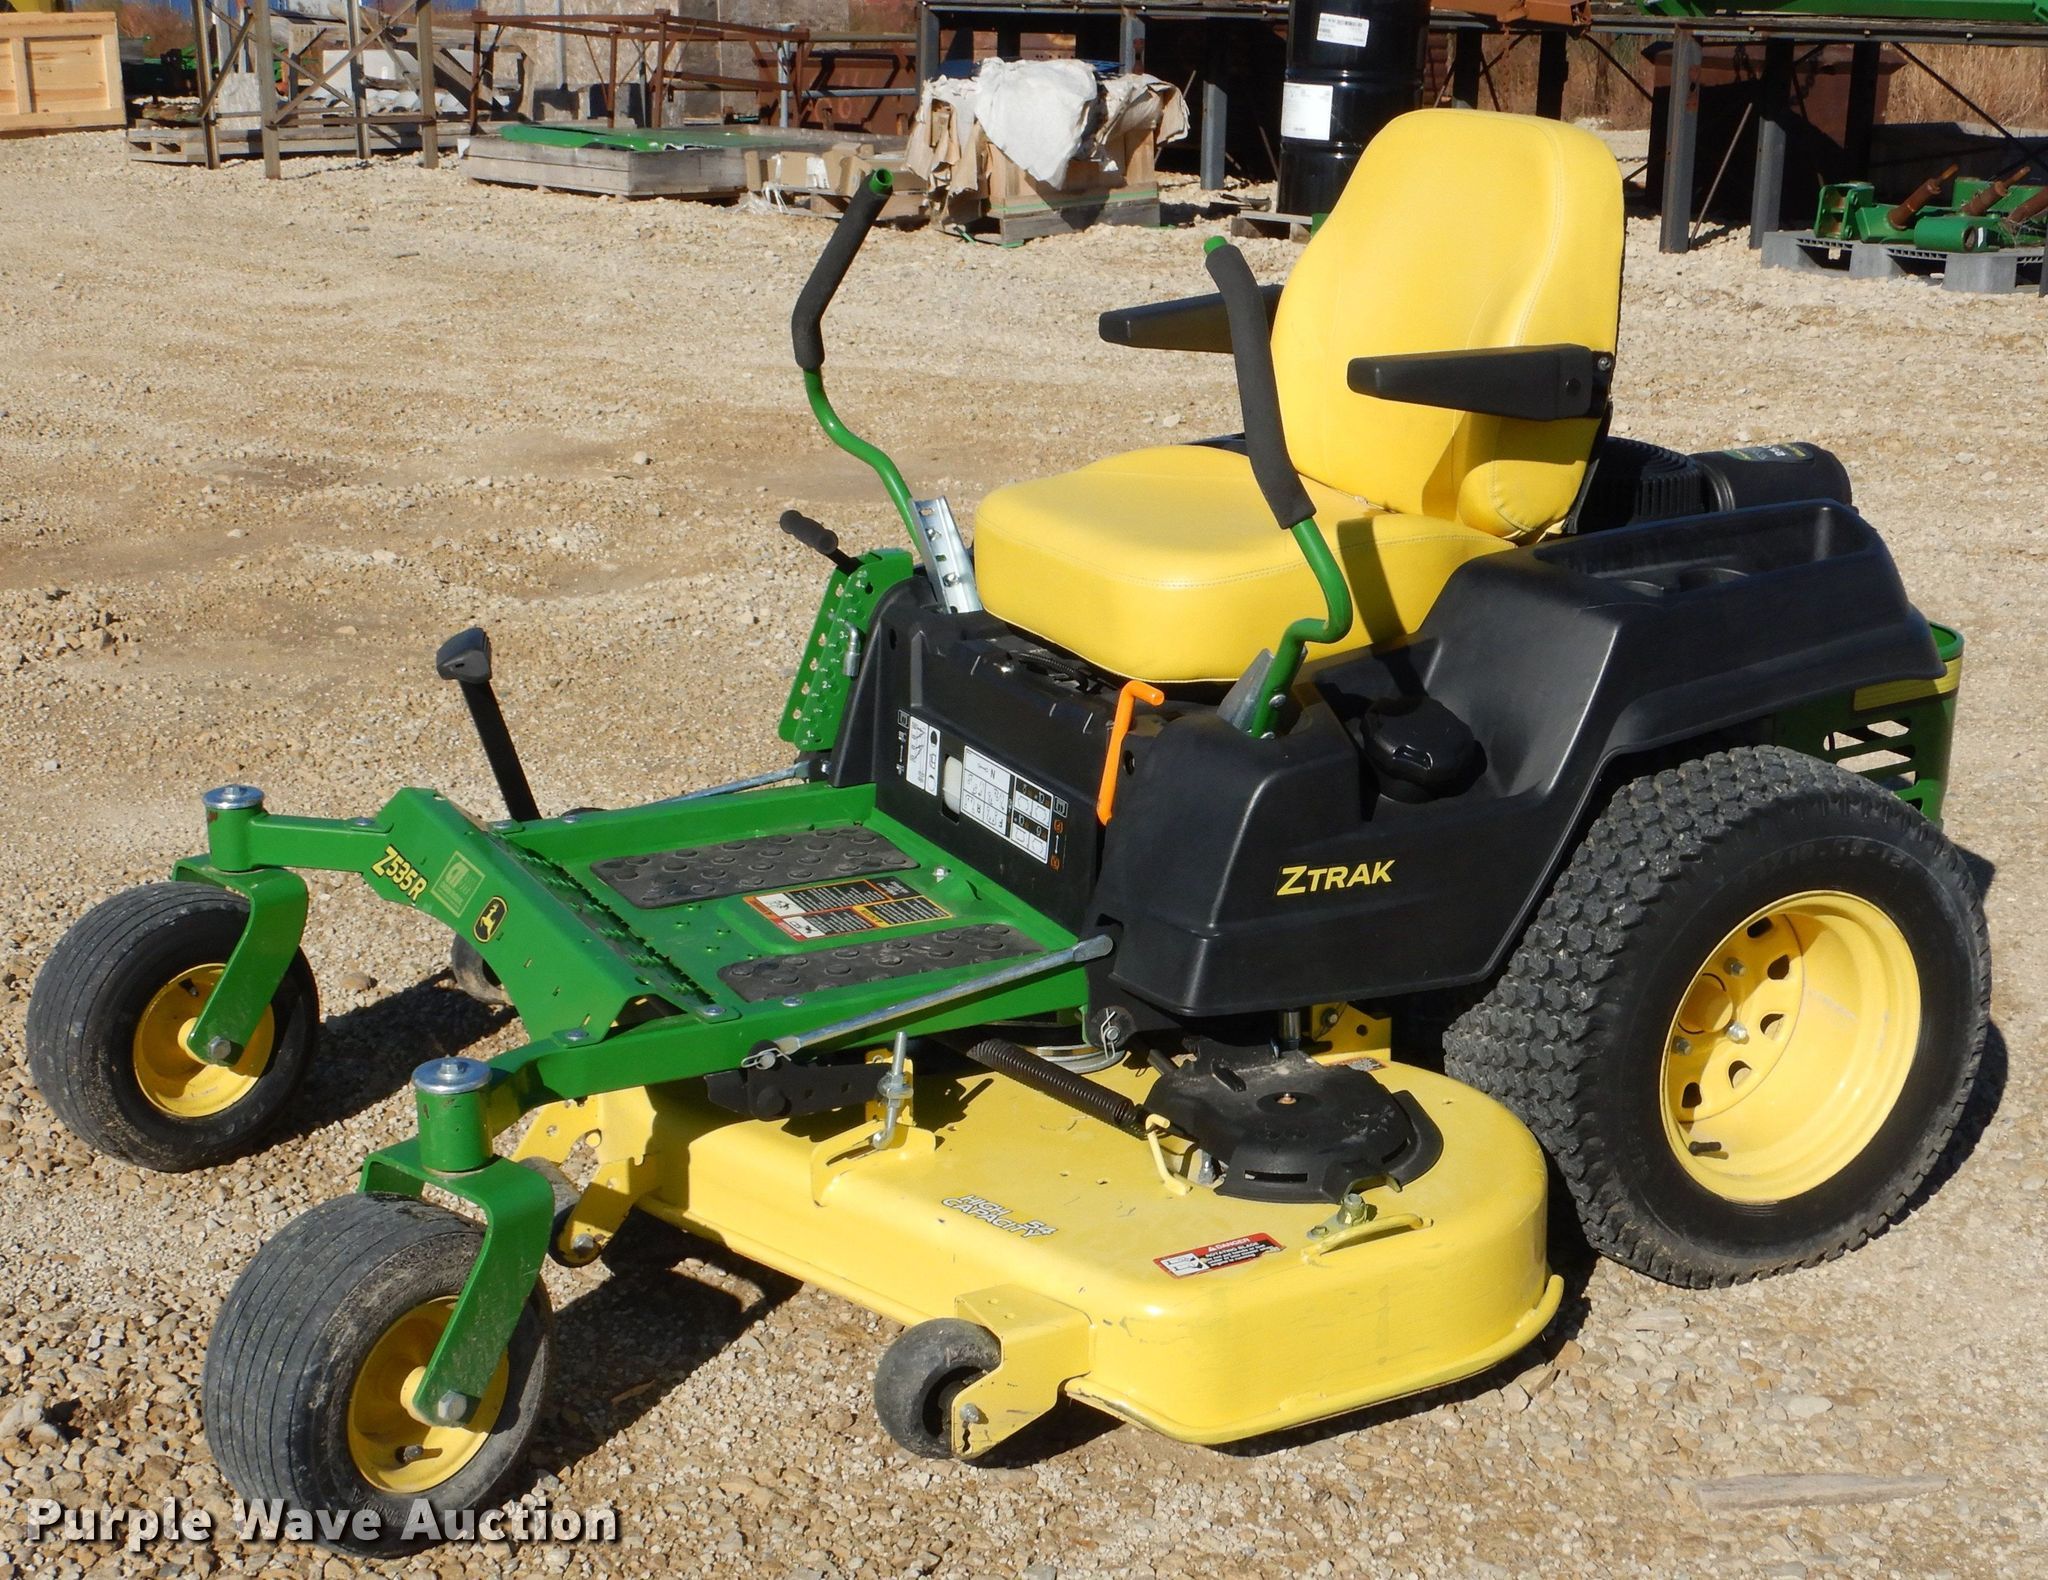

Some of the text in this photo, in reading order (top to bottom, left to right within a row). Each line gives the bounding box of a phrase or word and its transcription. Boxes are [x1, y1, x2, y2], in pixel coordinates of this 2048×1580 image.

[371, 844, 428, 902] Z535R
[1276, 859, 1396, 896] ZTRAK
[941, 1197, 1043, 1238] CAPACITY
[959, 1194, 1058, 1236] HIGH 54
[1215, 1237, 1251, 1250] DANGER
